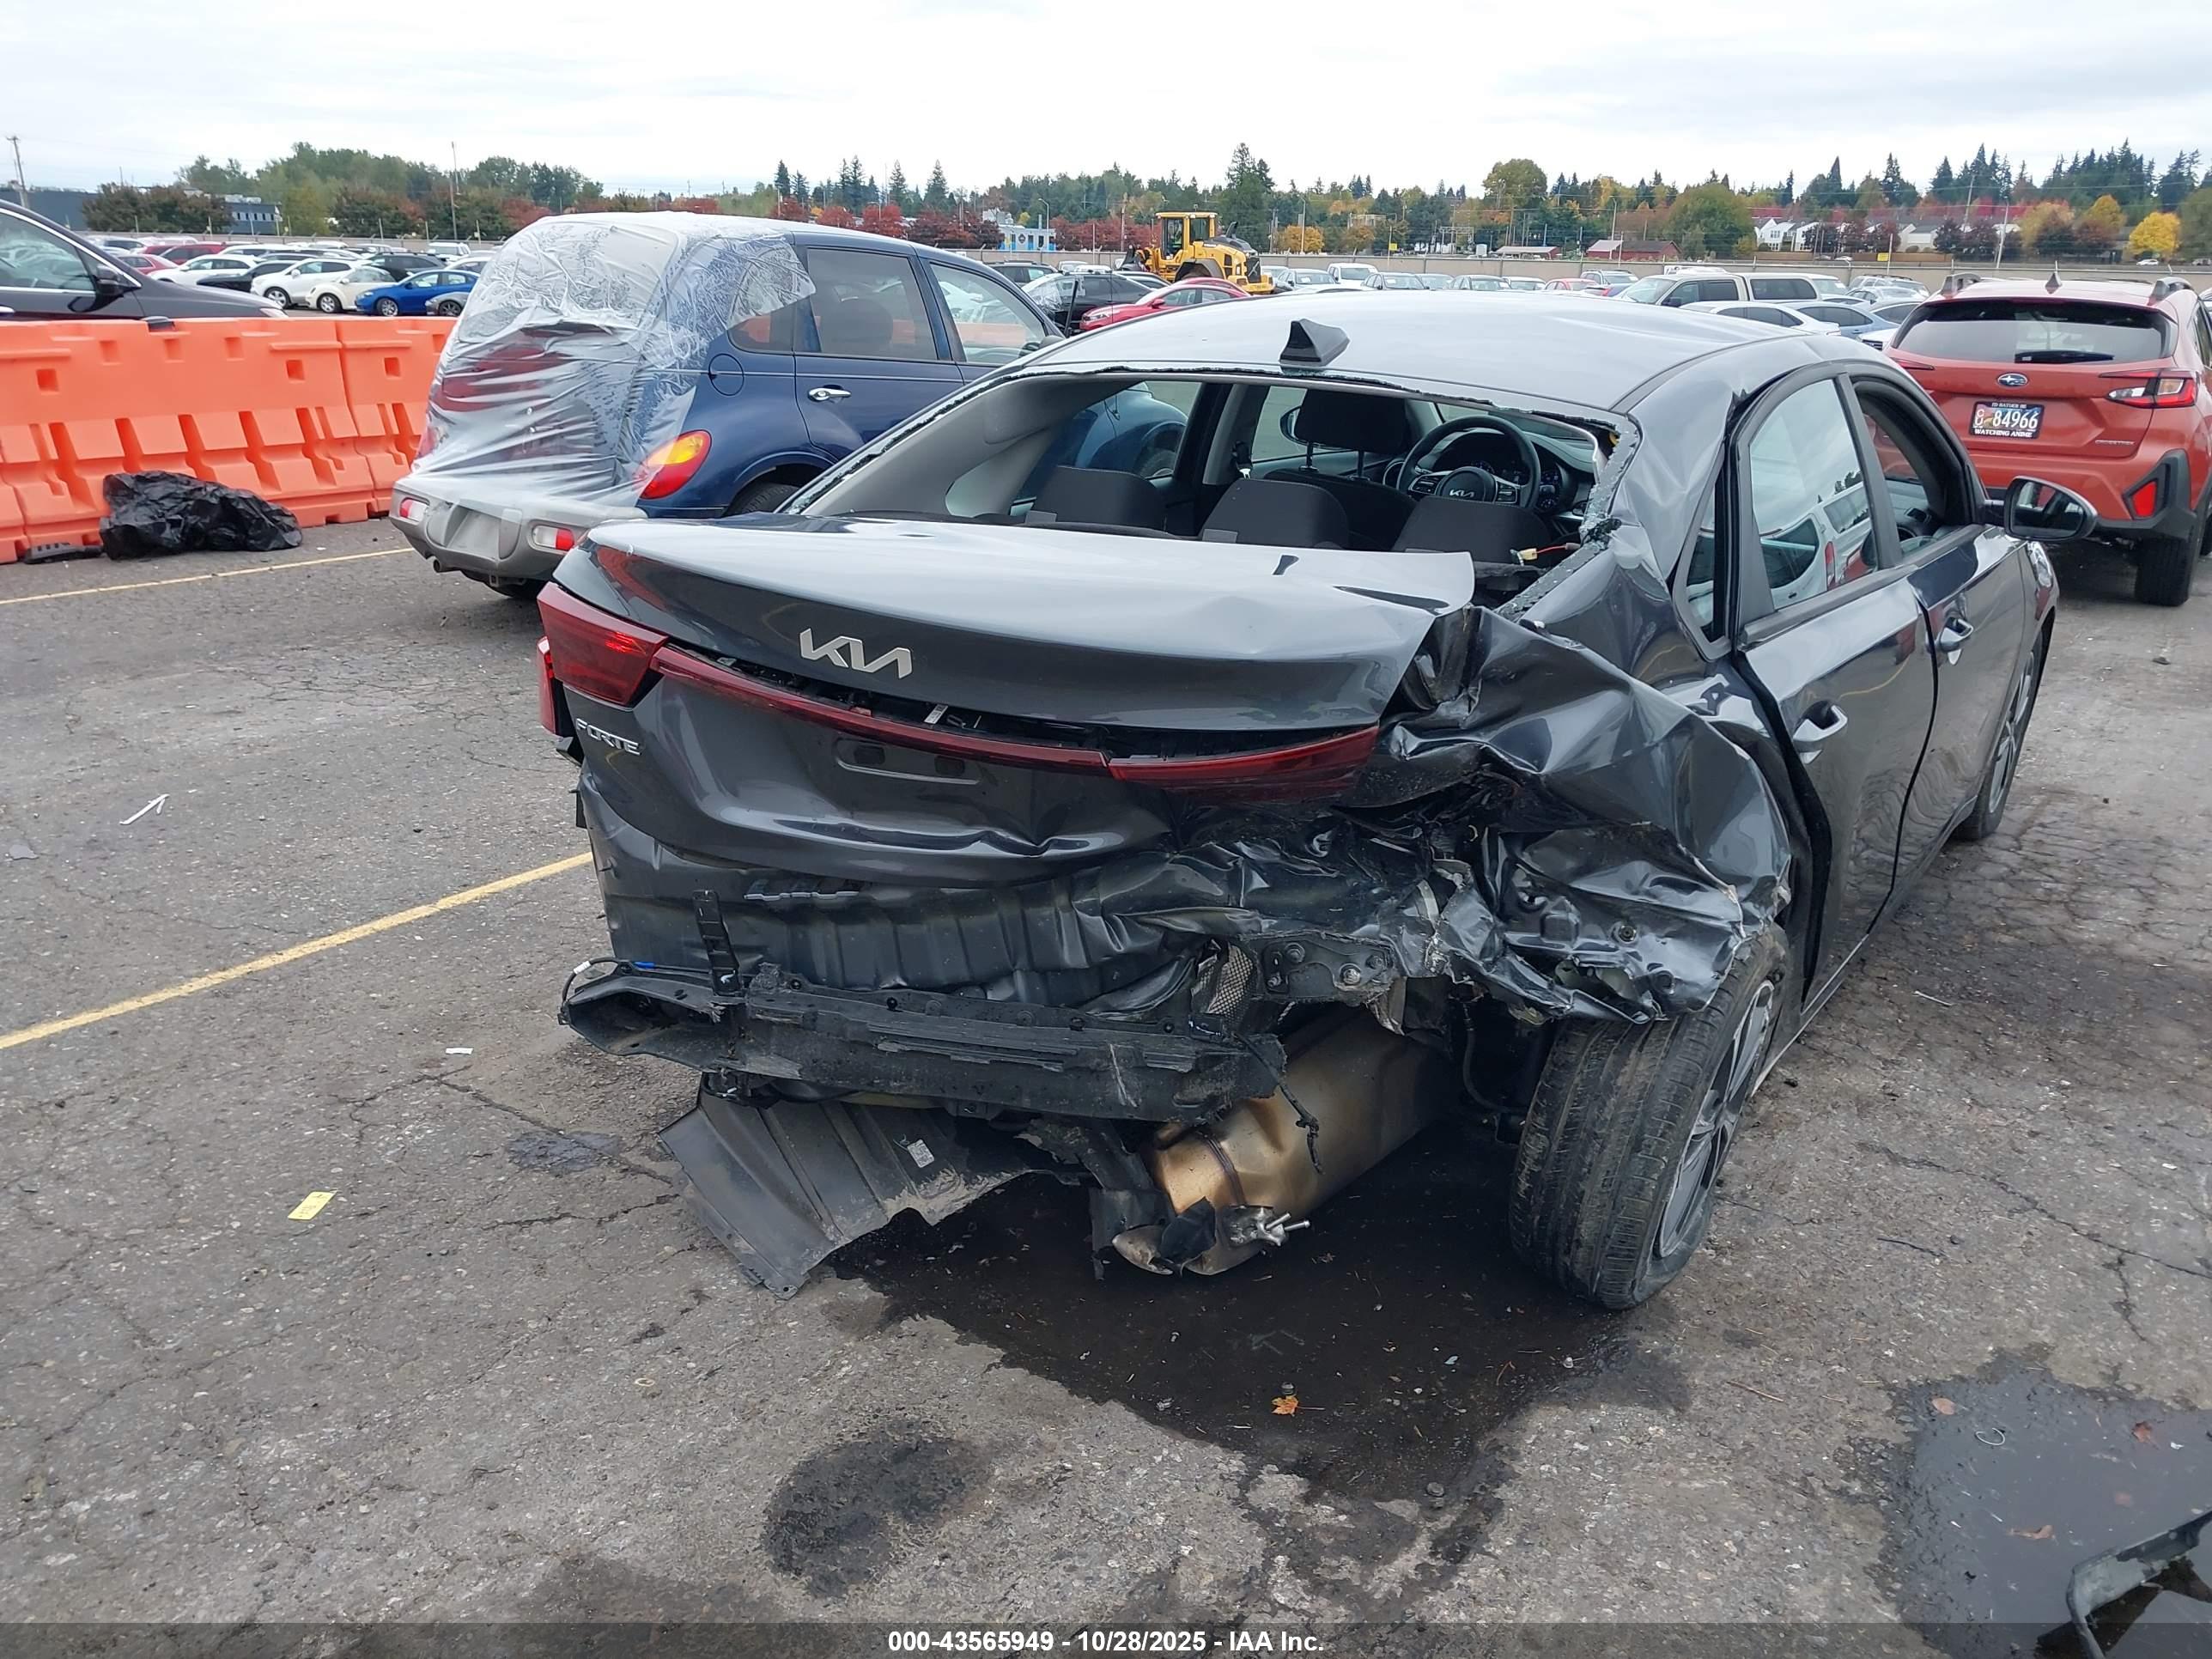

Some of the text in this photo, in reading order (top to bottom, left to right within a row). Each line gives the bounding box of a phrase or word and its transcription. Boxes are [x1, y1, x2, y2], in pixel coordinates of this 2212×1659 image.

[1993, 410, 2039, 429] 84966
[799, 628, 913, 679] KIA
[576, 718, 641, 756] FORTE
